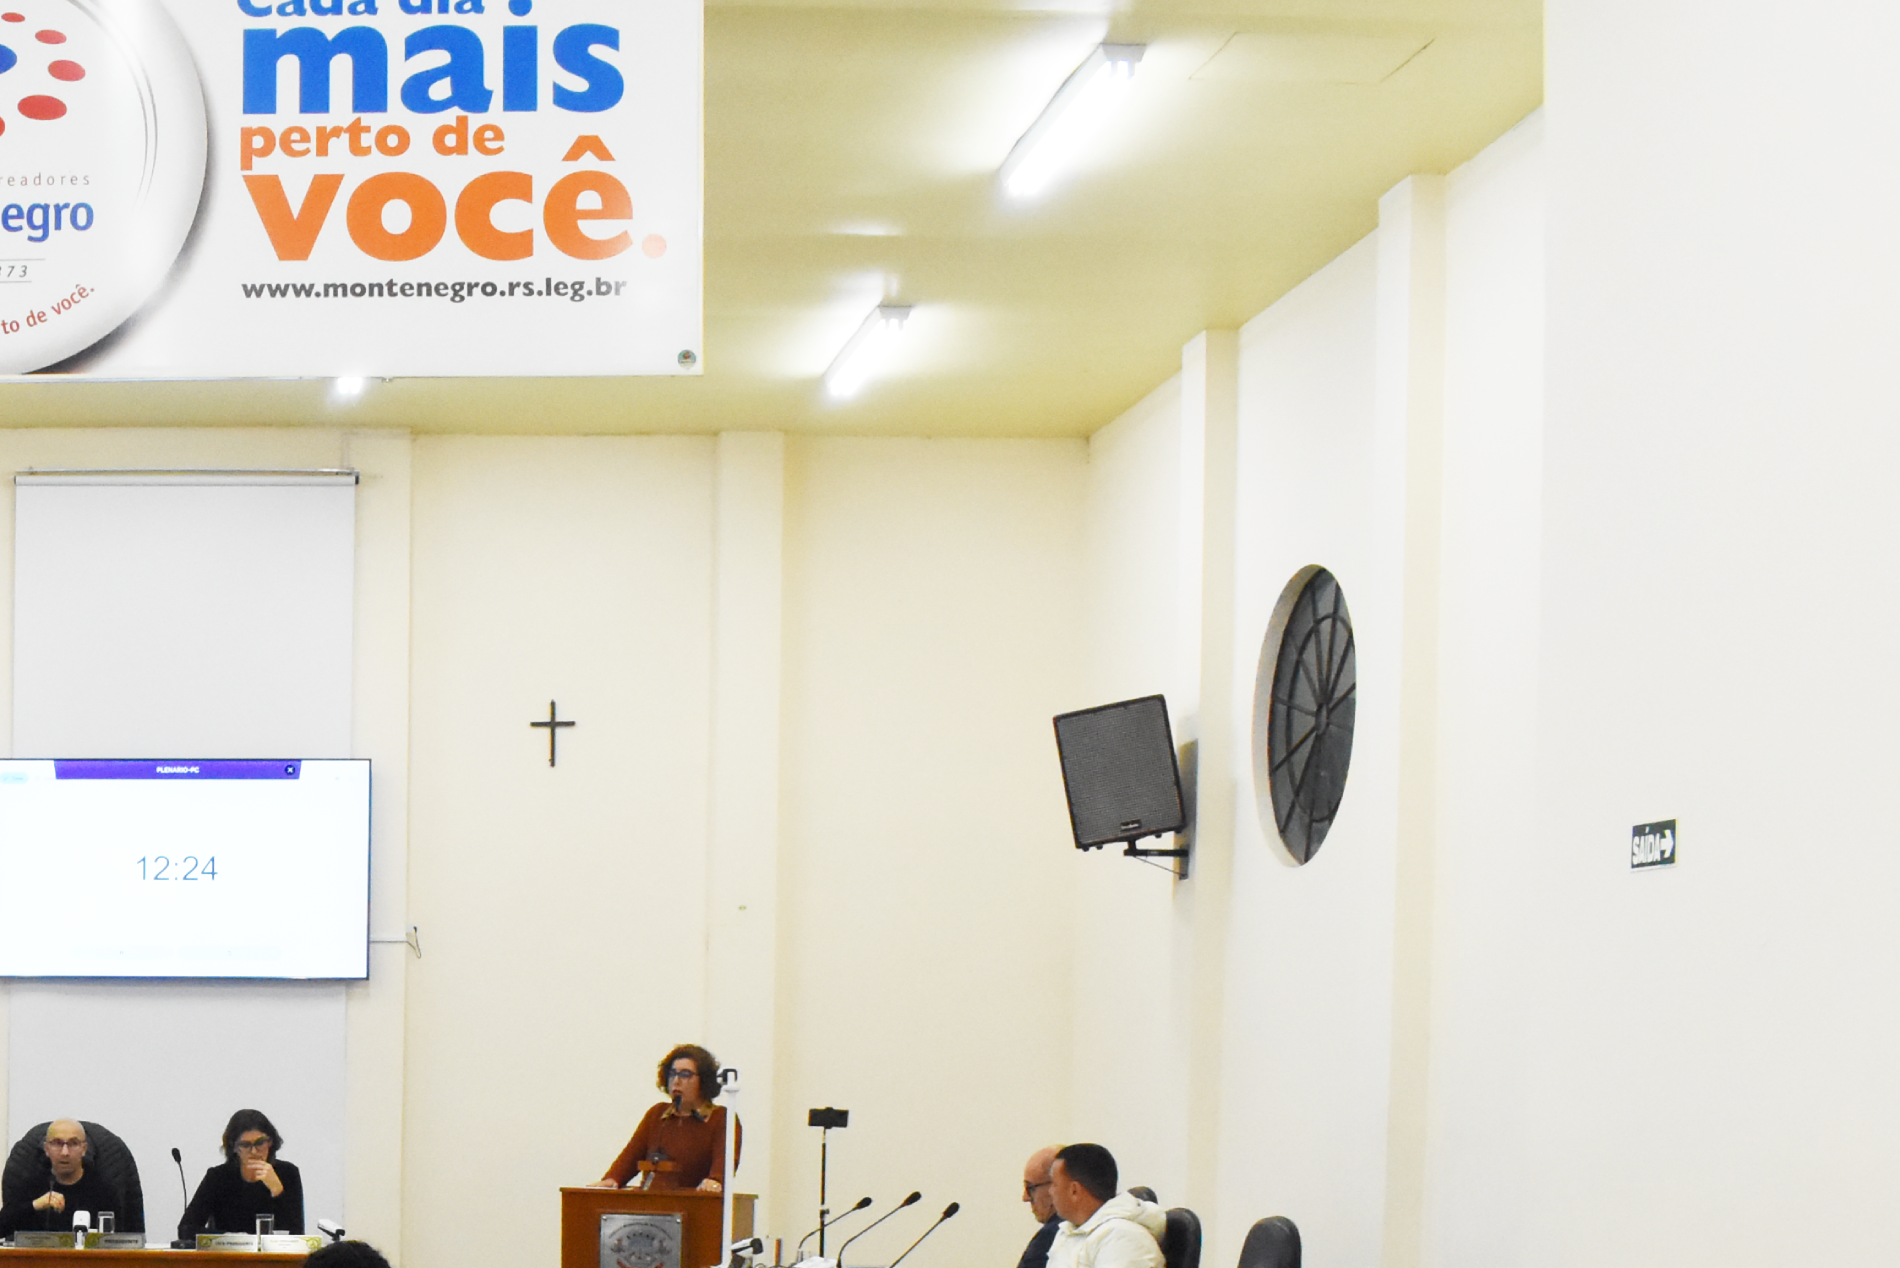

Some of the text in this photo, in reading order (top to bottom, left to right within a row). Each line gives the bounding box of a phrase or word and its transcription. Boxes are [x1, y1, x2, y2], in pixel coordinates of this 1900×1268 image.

[243, 0, 625, 114] mais
[240, 115, 506, 170] perto de
[242, 135, 667, 261] você.
[26, 310, 48, 328] de
[50, 283, 95, 316] você.
[241, 277, 628, 303] www.montenegro.rs.leg.br
[137, 855, 218, 881] 12:24
